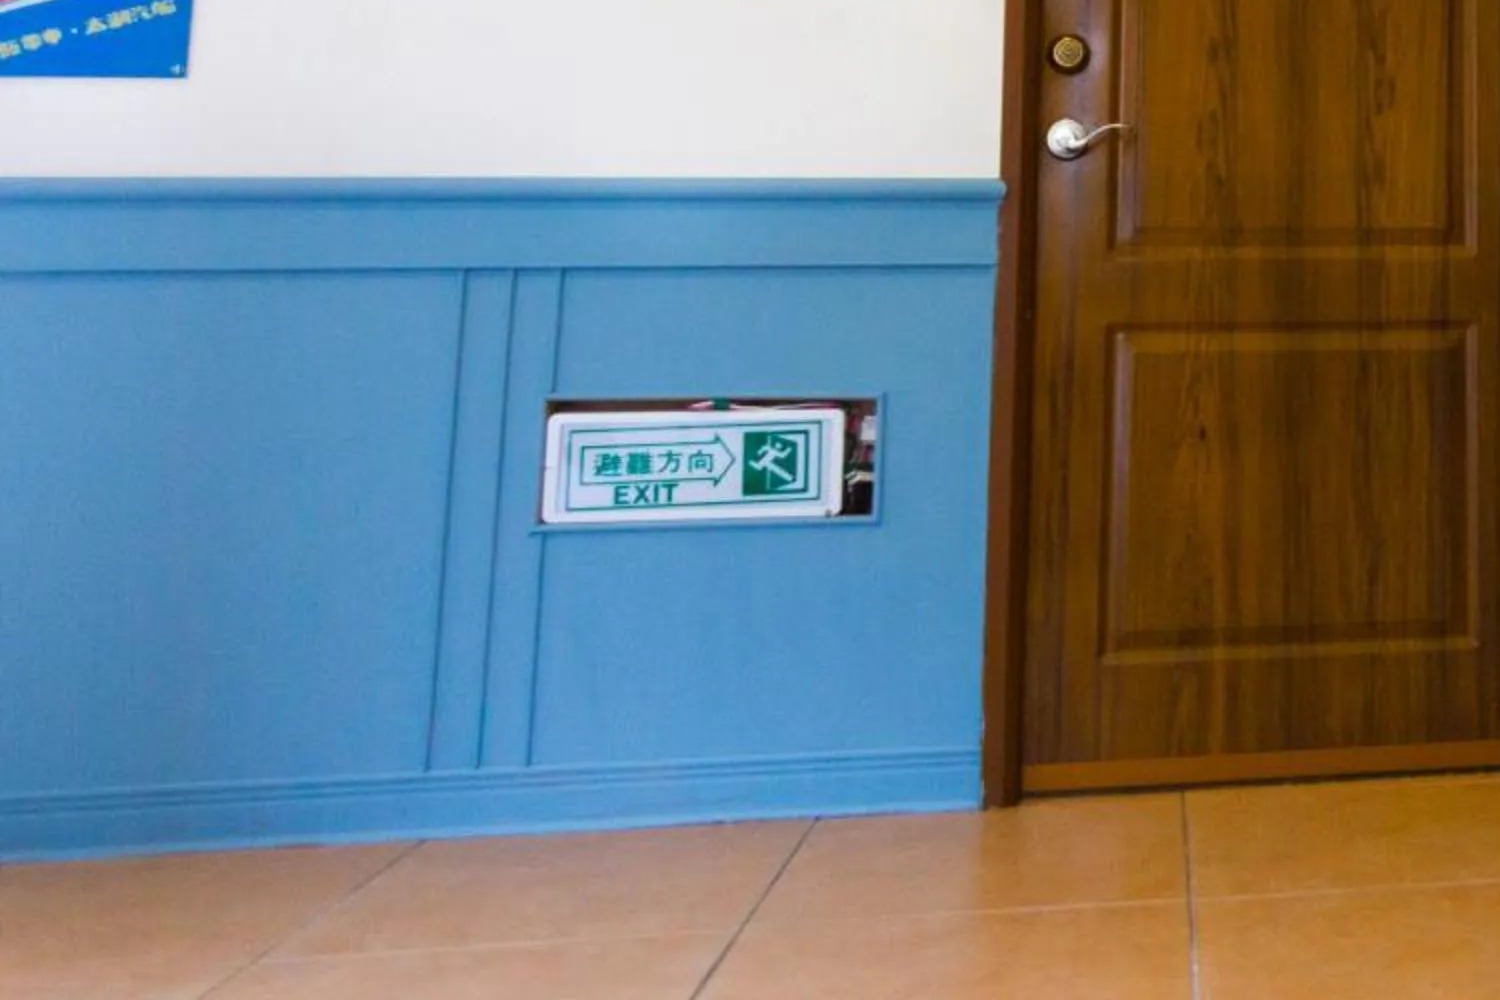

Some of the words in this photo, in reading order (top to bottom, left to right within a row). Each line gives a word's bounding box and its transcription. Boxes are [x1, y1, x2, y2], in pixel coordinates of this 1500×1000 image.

[593, 449, 714, 476] 避難方向
[614, 483, 679, 505] EXIT
